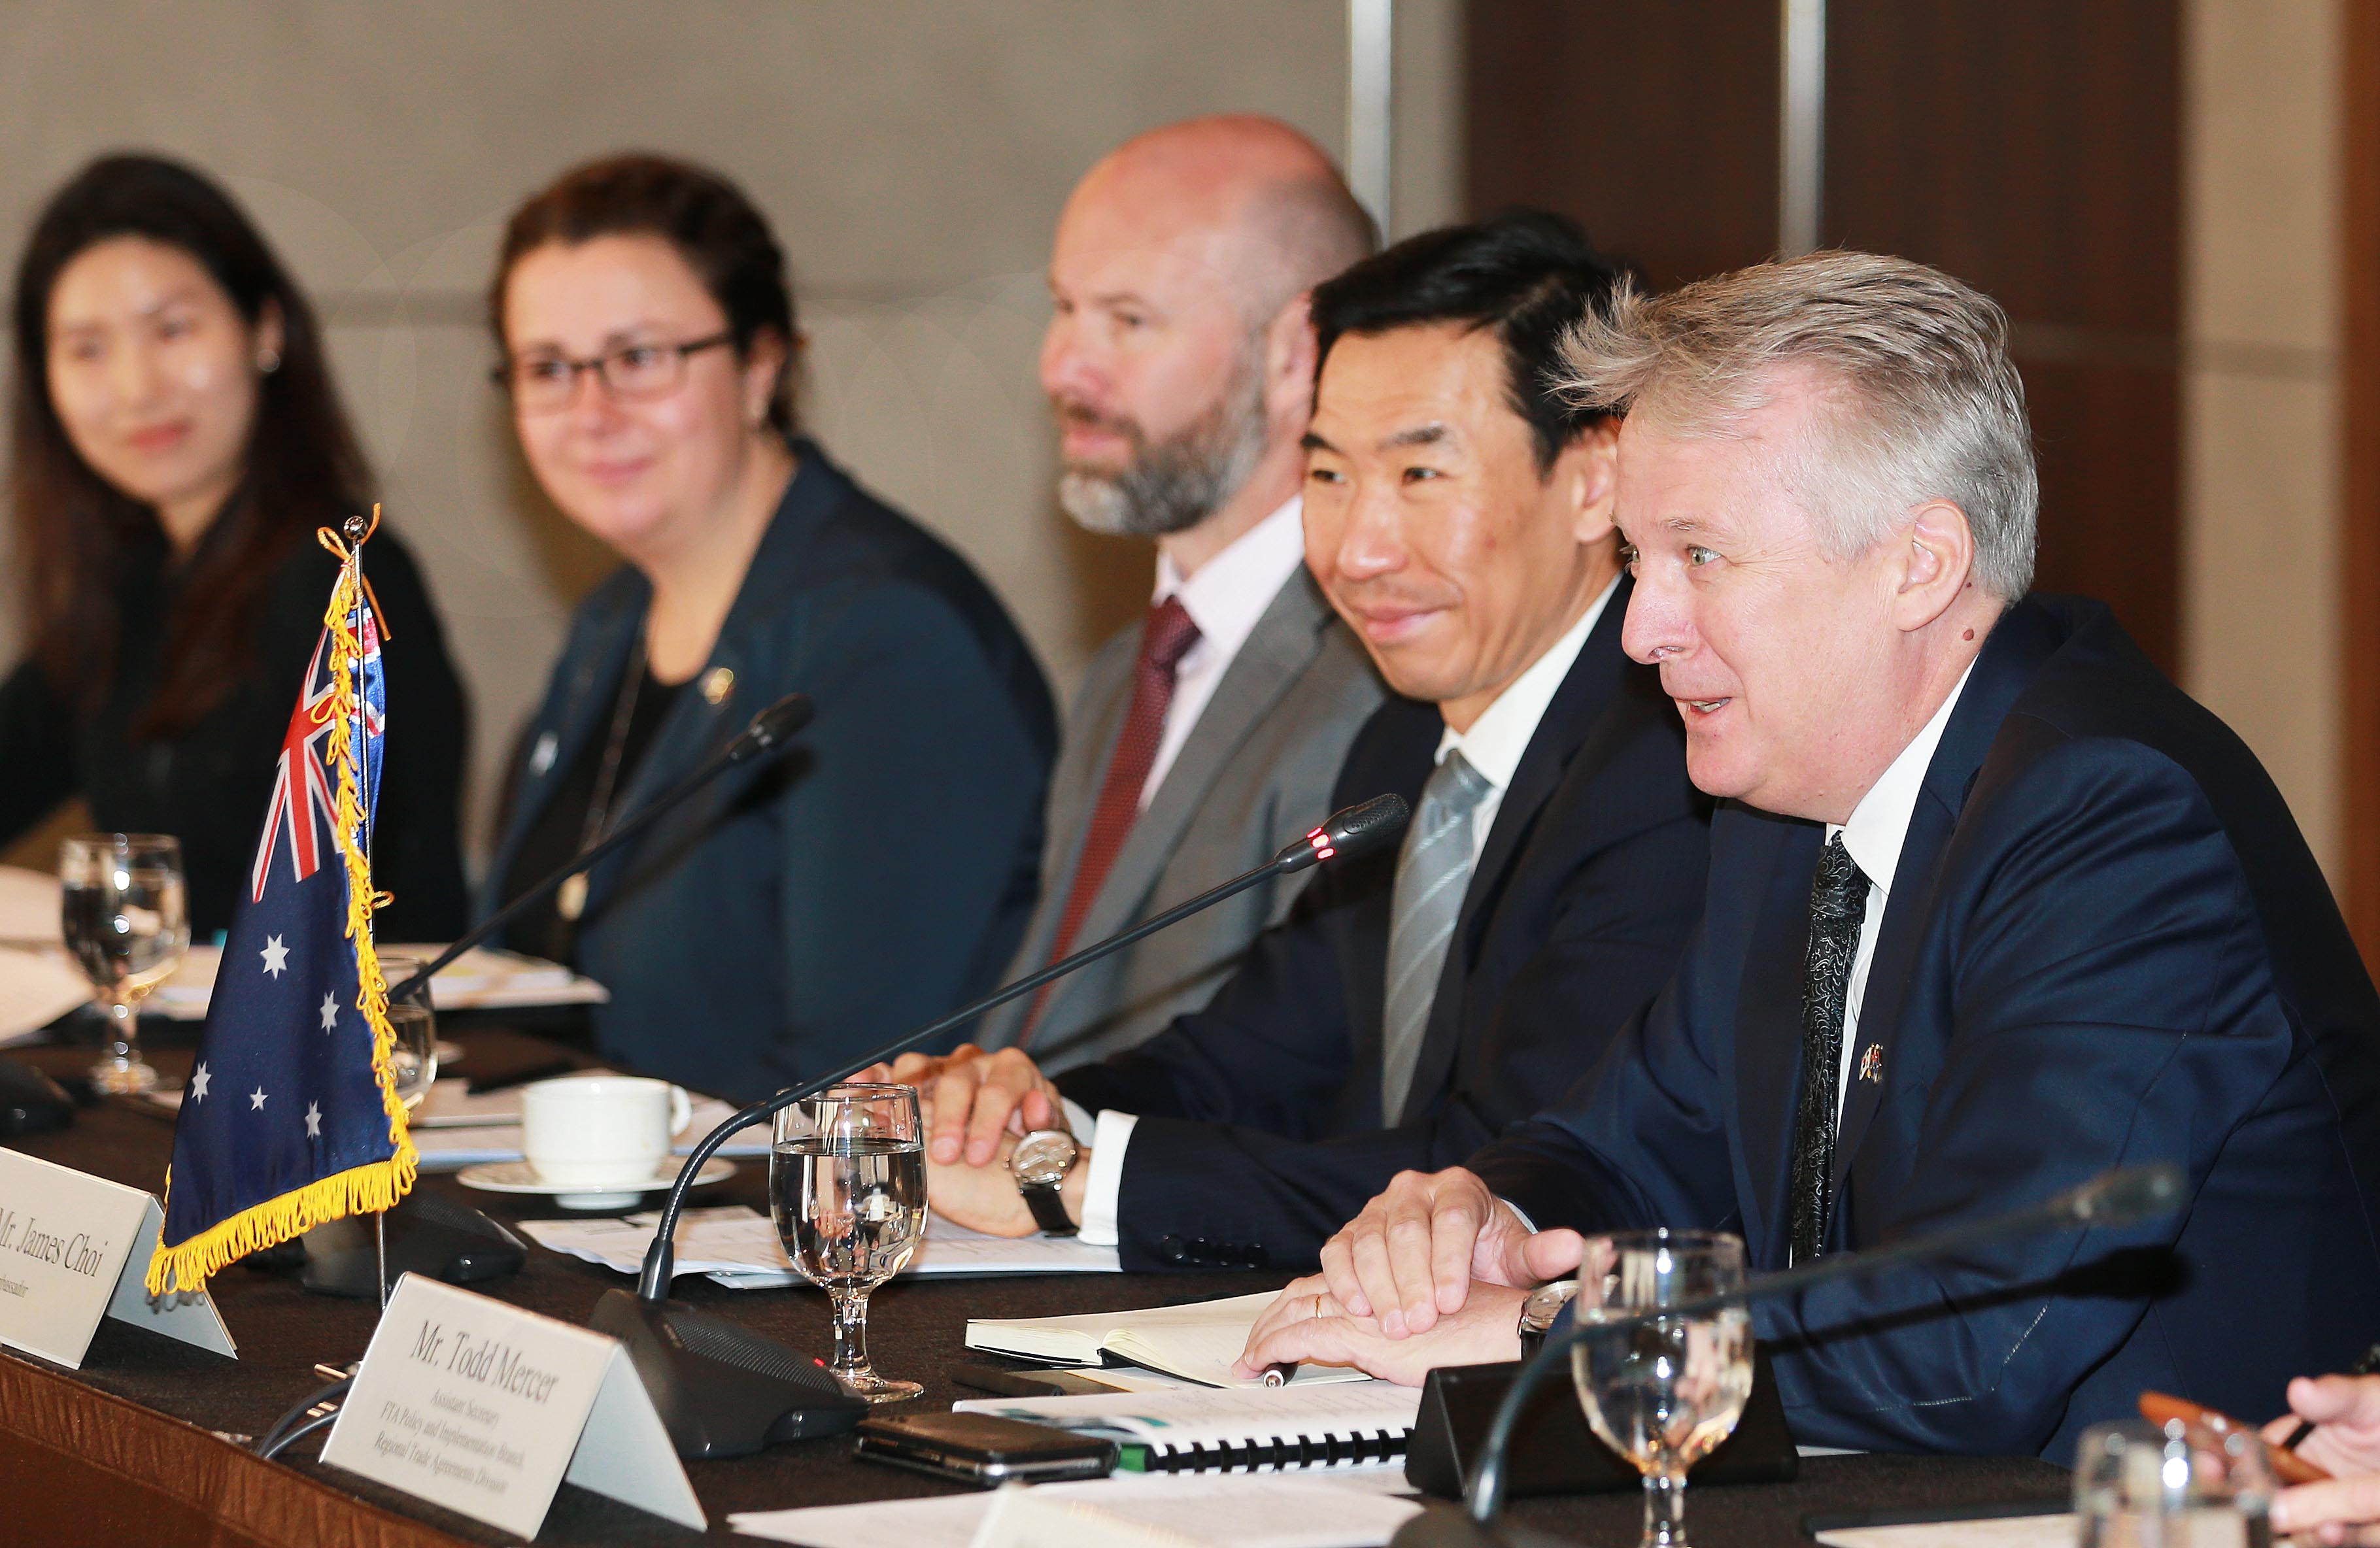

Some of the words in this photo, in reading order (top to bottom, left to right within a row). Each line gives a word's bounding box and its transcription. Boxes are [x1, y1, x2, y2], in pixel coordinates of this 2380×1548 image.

[16, 1217, 65, 1264] James
[65, 1233, 109, 1277] Choi
[410, 1319, 443, 1367] Mr.
[447, 1332, 500, 1383] Todd
[492, 1347, 560, 1404] Mercer
[380, 1400, 400, 1422] FTA
[399, 1407, 424, 1436] Policy
[424, 1419, 443, 1437] and
[374, 1430, 411, 1458] Regional
[409, 1442, 432, 1465] Trade
